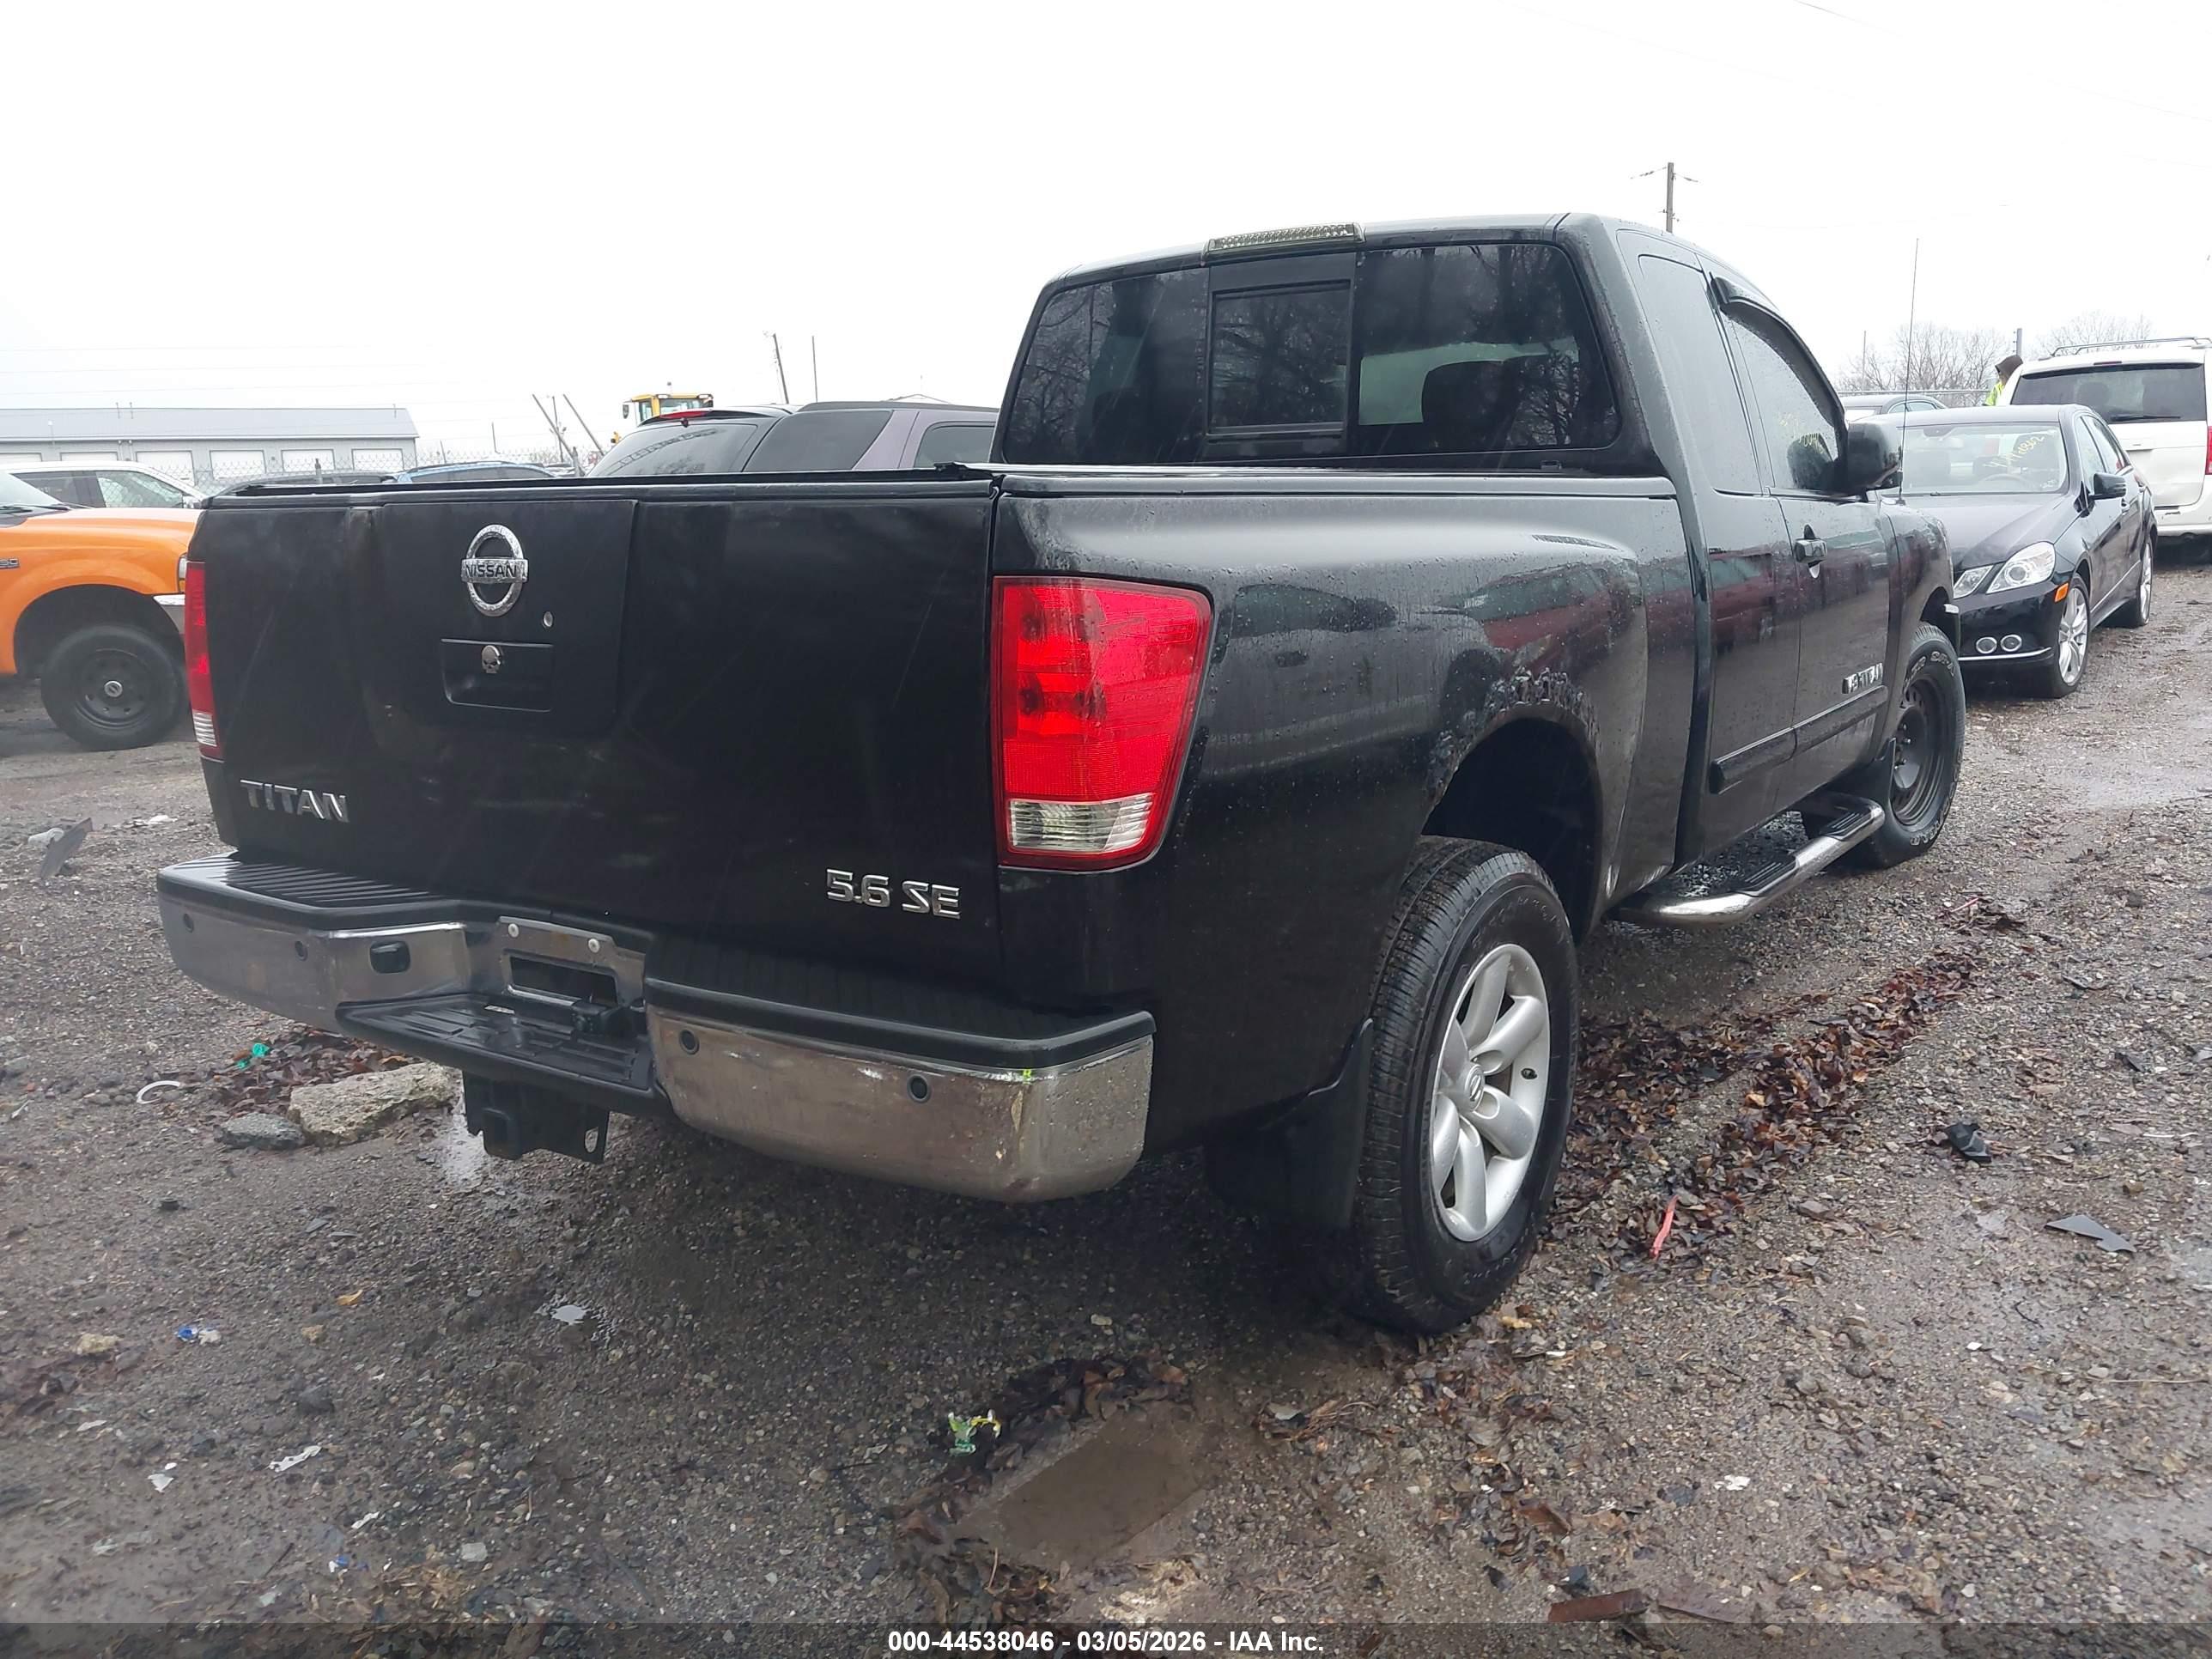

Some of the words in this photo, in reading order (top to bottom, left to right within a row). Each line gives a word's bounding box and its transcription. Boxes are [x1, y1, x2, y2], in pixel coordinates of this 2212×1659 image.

[465, 564, 517, 578] NISSAN
[240, 779, 349, 823] TITAN
[825, 867, 891, 908] 5.6
[901, 879, 961, 920] SE
